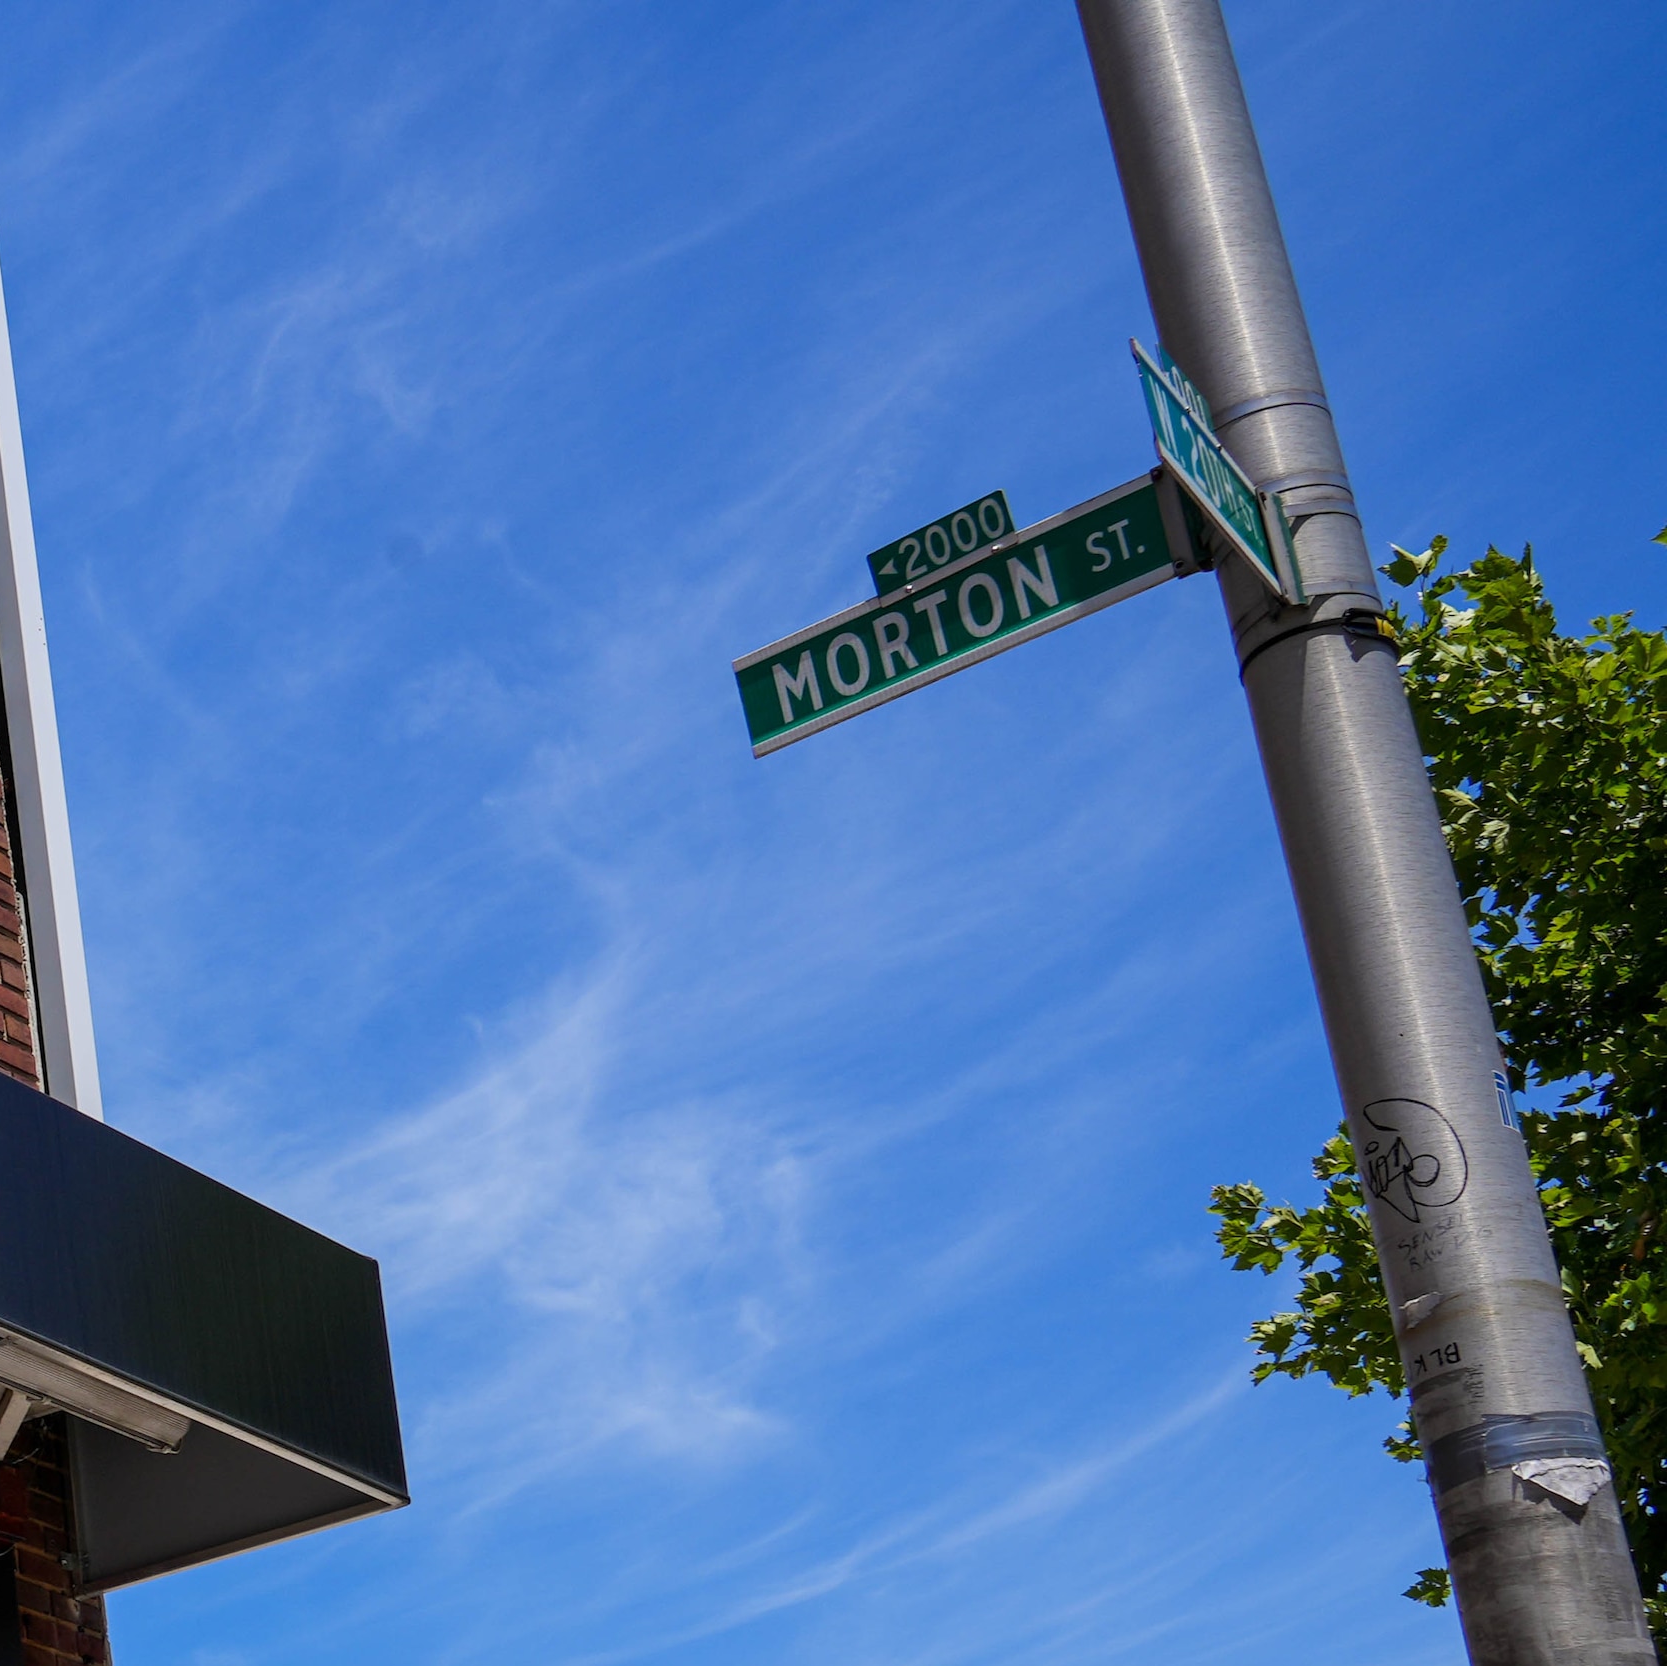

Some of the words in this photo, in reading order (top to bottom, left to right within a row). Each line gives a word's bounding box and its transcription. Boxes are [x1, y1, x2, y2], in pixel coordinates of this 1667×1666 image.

[898, 497, 1006, 581] 2000
[771, 546, 1060, 724] MORTON
[1086, 519, 1146, 573] ST.
